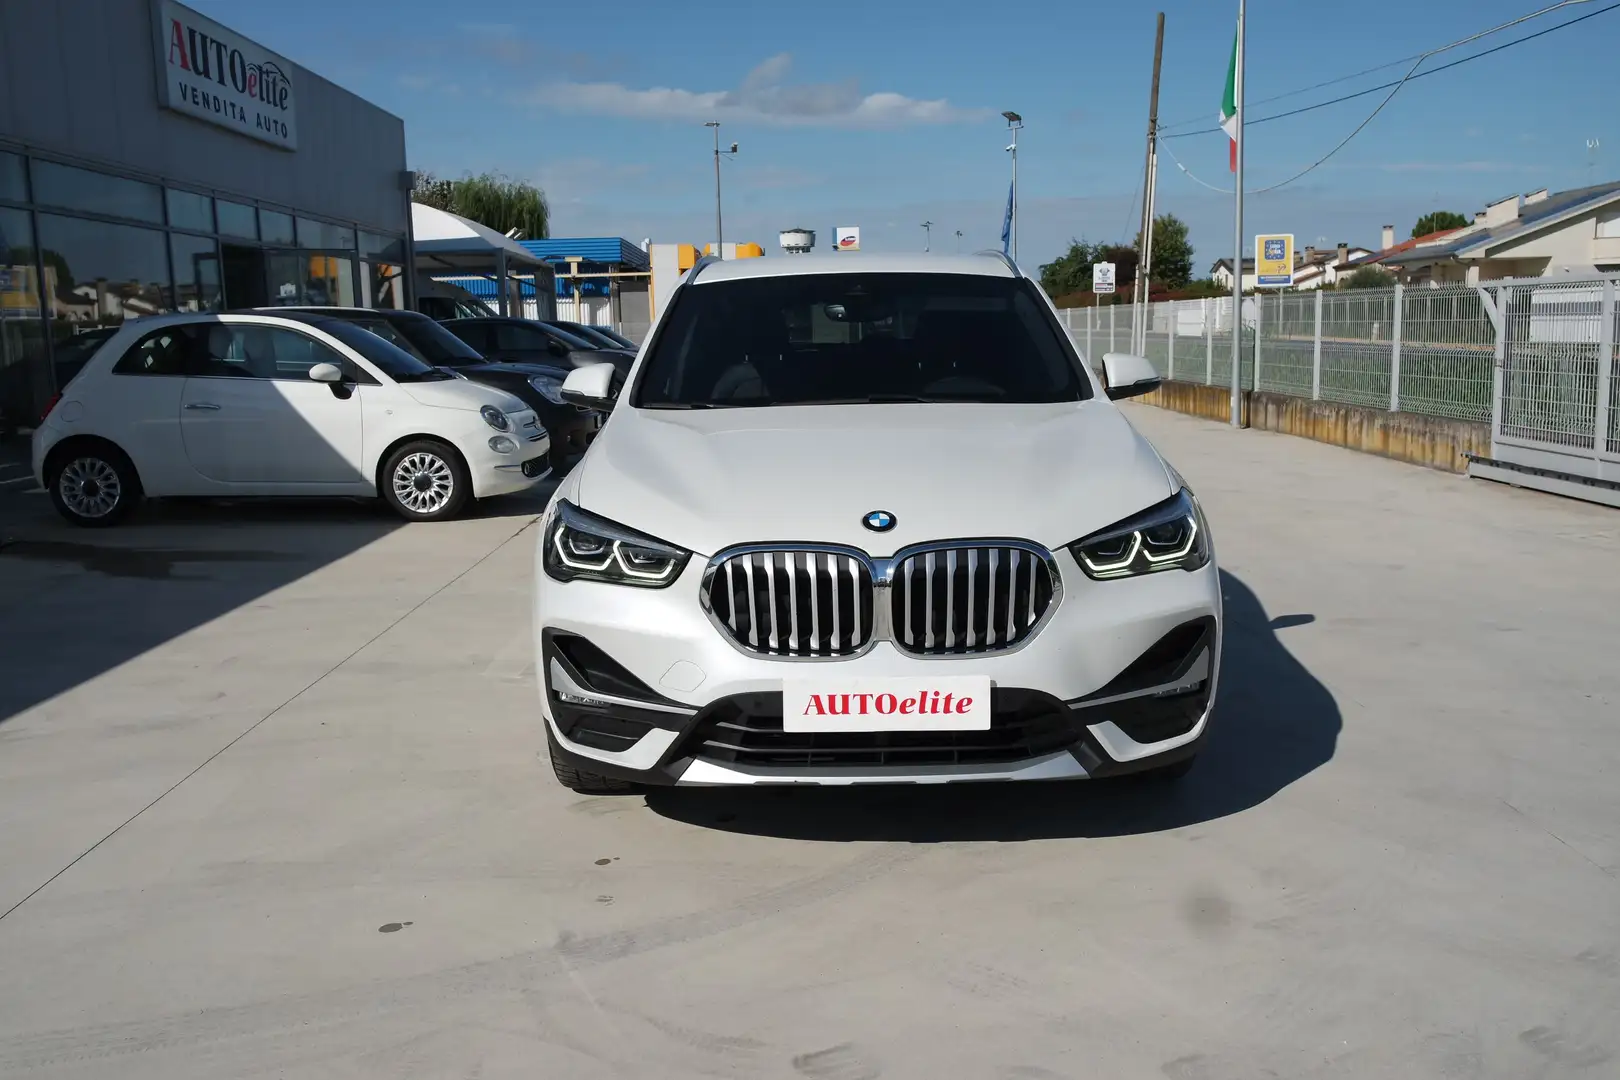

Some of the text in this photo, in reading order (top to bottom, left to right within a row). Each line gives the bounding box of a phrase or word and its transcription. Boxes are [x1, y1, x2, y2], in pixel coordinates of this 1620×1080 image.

[168, 18, 289, 111] AUTOelite
[178, 81, 288, 139] VENDITA AUTO
[802, 690, 974, 716] AUTOelite
